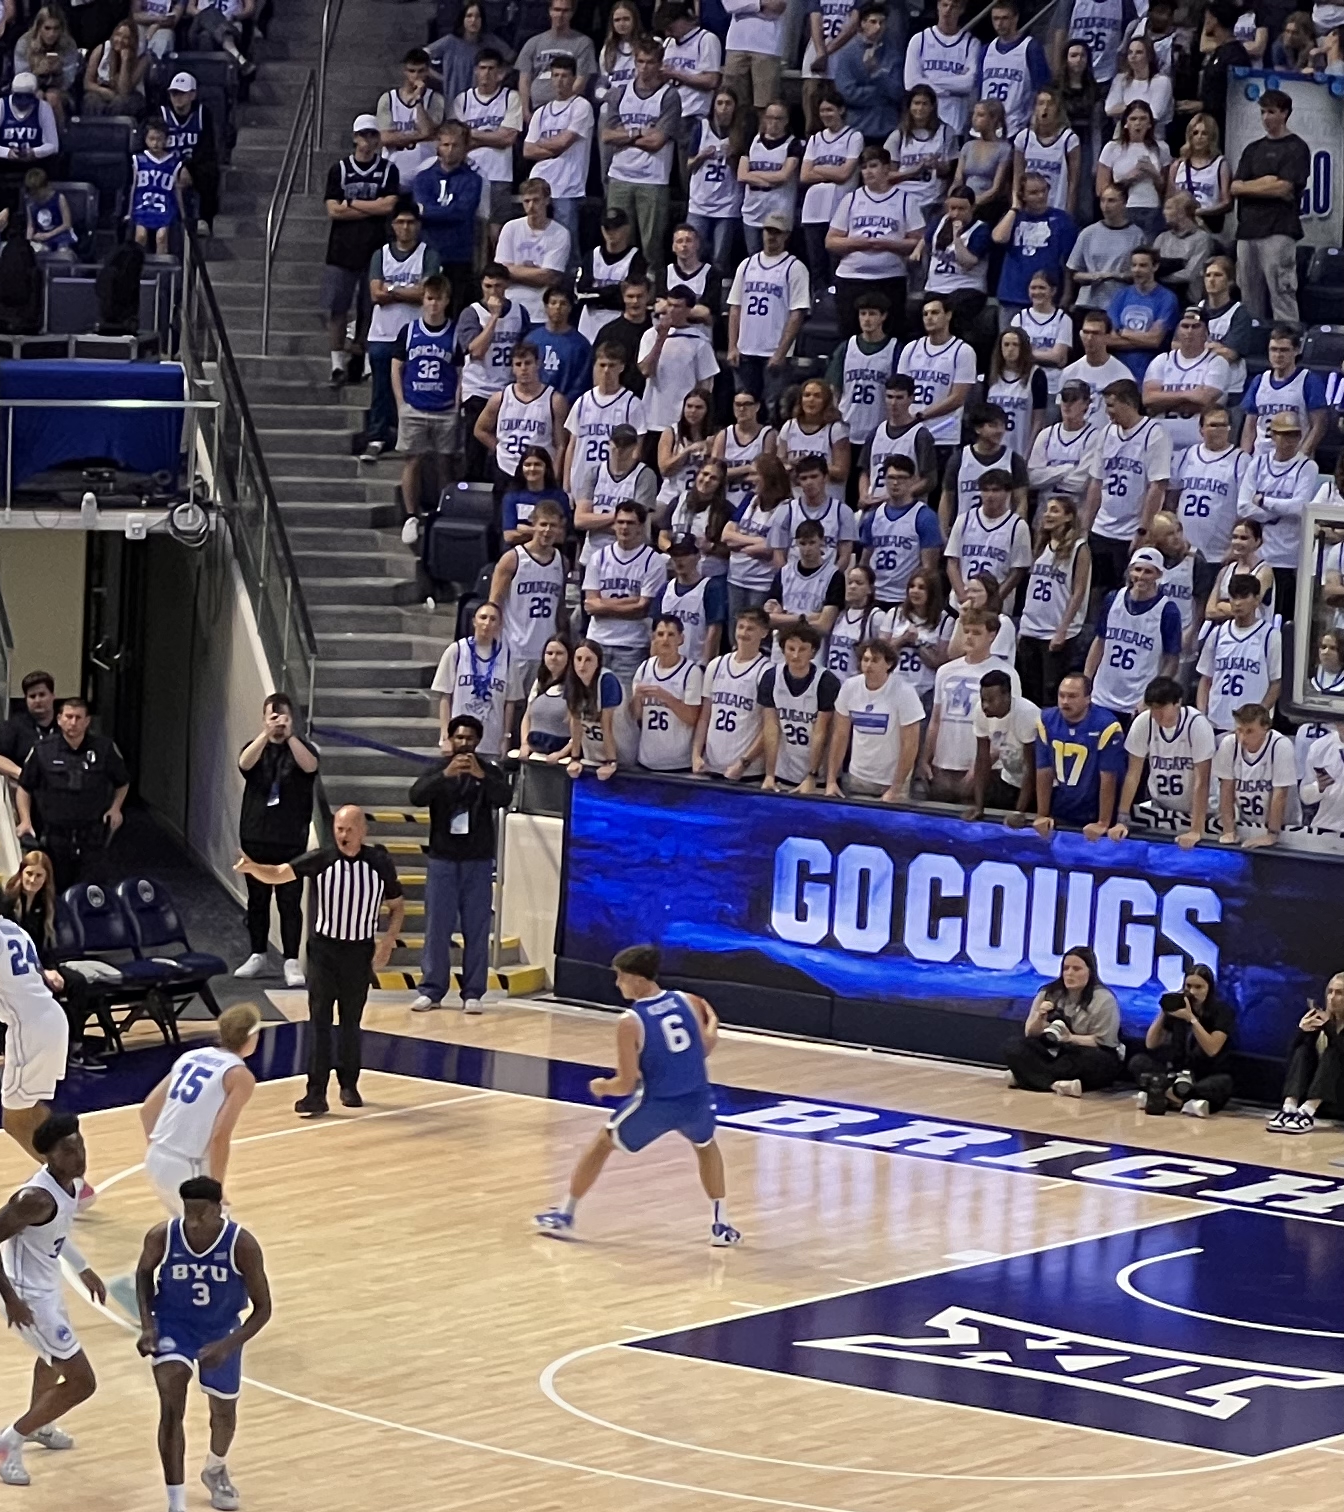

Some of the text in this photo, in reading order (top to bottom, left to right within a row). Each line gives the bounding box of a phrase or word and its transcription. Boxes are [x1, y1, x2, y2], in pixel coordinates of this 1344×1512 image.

[3, 127, 38, 140] BYU
[137, 170, 175, 190] BYU
[748, 298, 768, 315] 26
[543, 347, 561, 371] LA
[418, 360, 440, 379] 32
[853, 386, 874, 403] 26
[912, 386, 933, 403] 26
[1108, 475, 1127, 496] 26
[1185, 495, 1209, 516] 26
[878, 551, 898, 570] 26
[1033, 583, 1052, 601] 26
[530, 598, 551, 617] 26
[830, 651, 848, 669] 26
[900, 651, 921, 670] 26
[1111, 647, 1136, 669] 26
[1222, 676, 1243, 696] 26
[649, 711, 668, 729] 26
[716, 712, 735, 731] 26
[785, 725, 809, 744] 26
[1052, 742, 1088, 786] 17
[1156, 774, 1184, 796] 26
[1240, 796, 1265, 816] 26
[769, 836, 1223, 993] GO COUGS
[660, 1013, 692, 1054] 6
[169, 1062, 211, 1104] 15
[171, 1263, 228, 1281] BYU
[192, 1283, 210, 1306] 3
